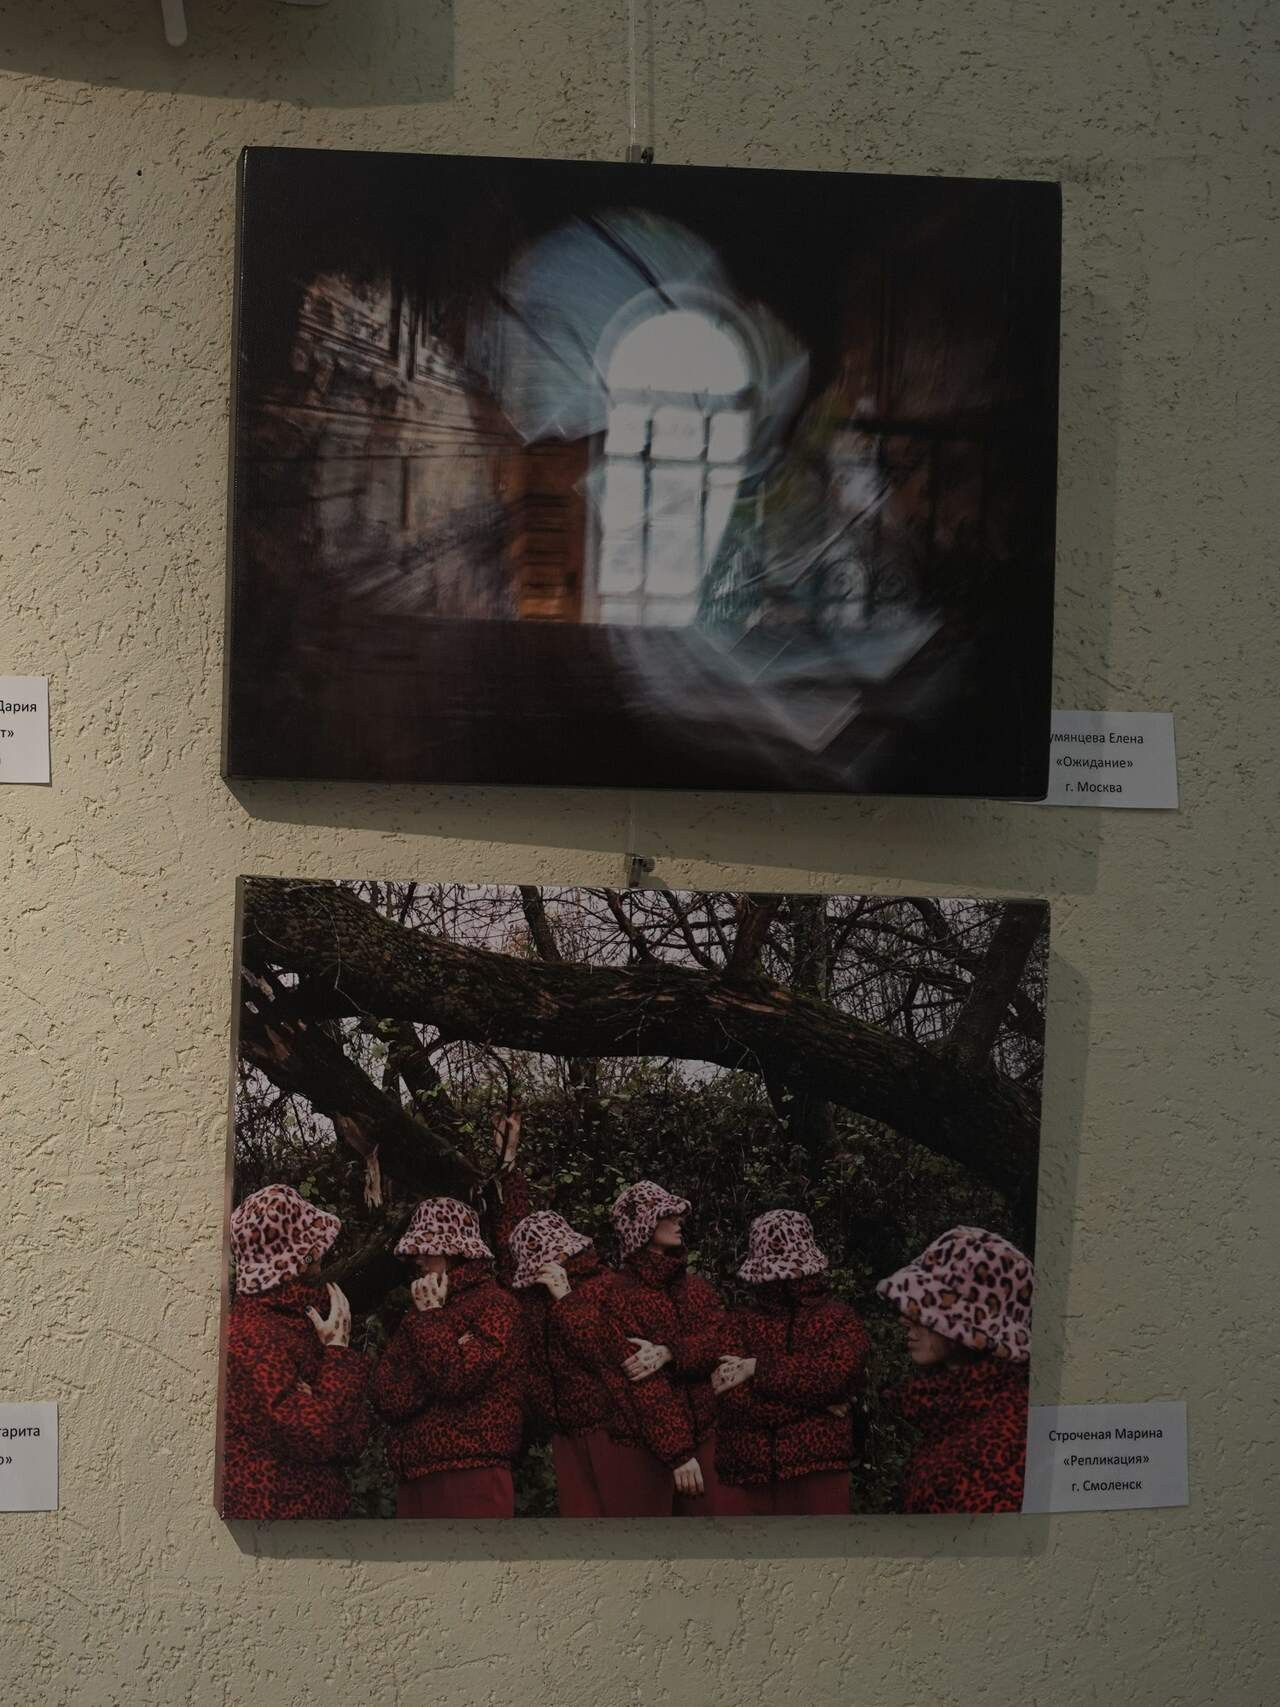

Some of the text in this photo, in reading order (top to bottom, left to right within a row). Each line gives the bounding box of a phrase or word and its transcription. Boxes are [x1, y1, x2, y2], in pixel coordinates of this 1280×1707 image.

[1049, 732, 1144, 744] умянцева Елена
[1056, 756, 1133, 769] «Ожидание»
[1065, 781, 1123, 793] г. Москва
[1048, 1428, 1163, 1443] Строченая Марина
[1063, 1455, 1150, 1467] «Репликация»
[1071, 1480, 1142, 1492] г. Смоленск
